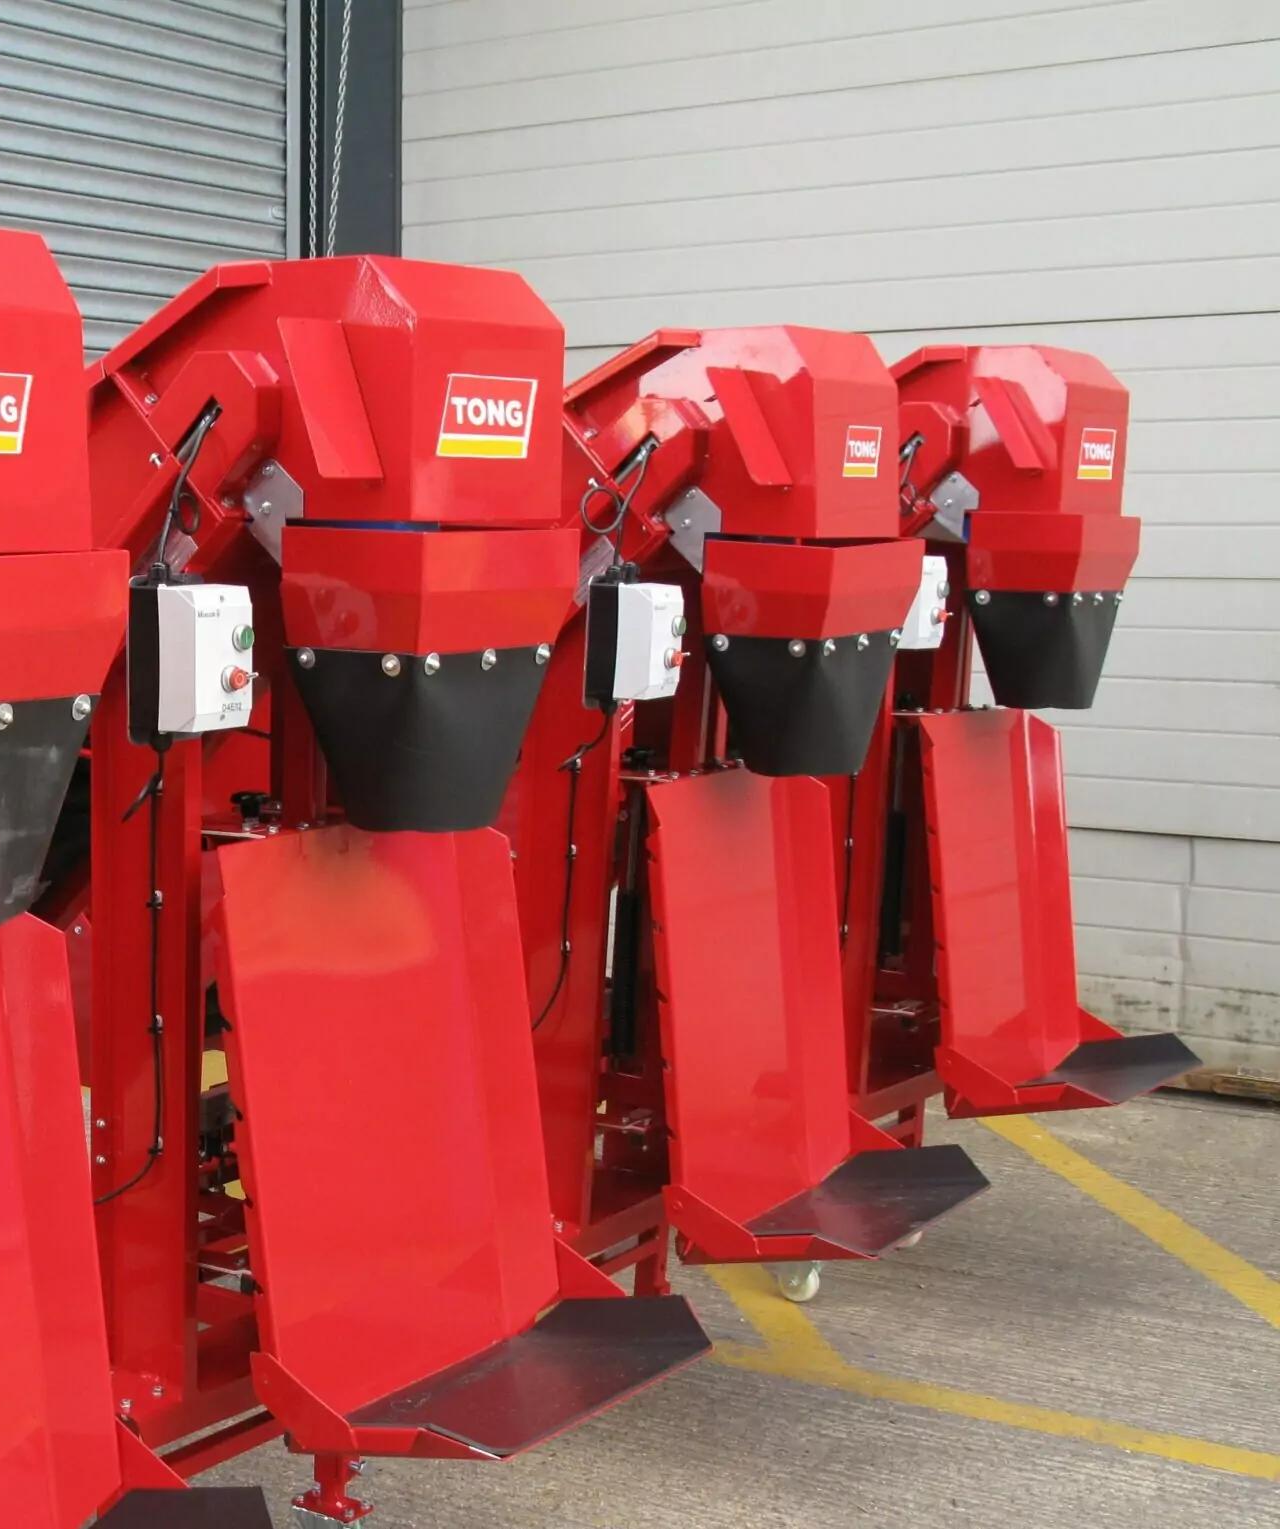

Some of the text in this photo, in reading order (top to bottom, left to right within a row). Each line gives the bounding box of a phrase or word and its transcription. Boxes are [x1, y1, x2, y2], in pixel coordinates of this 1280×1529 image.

[450, 396, 524, 428] TONG
[848, 440, 876, 458] TONG
[1083, 442, 1111, 460] TONG
